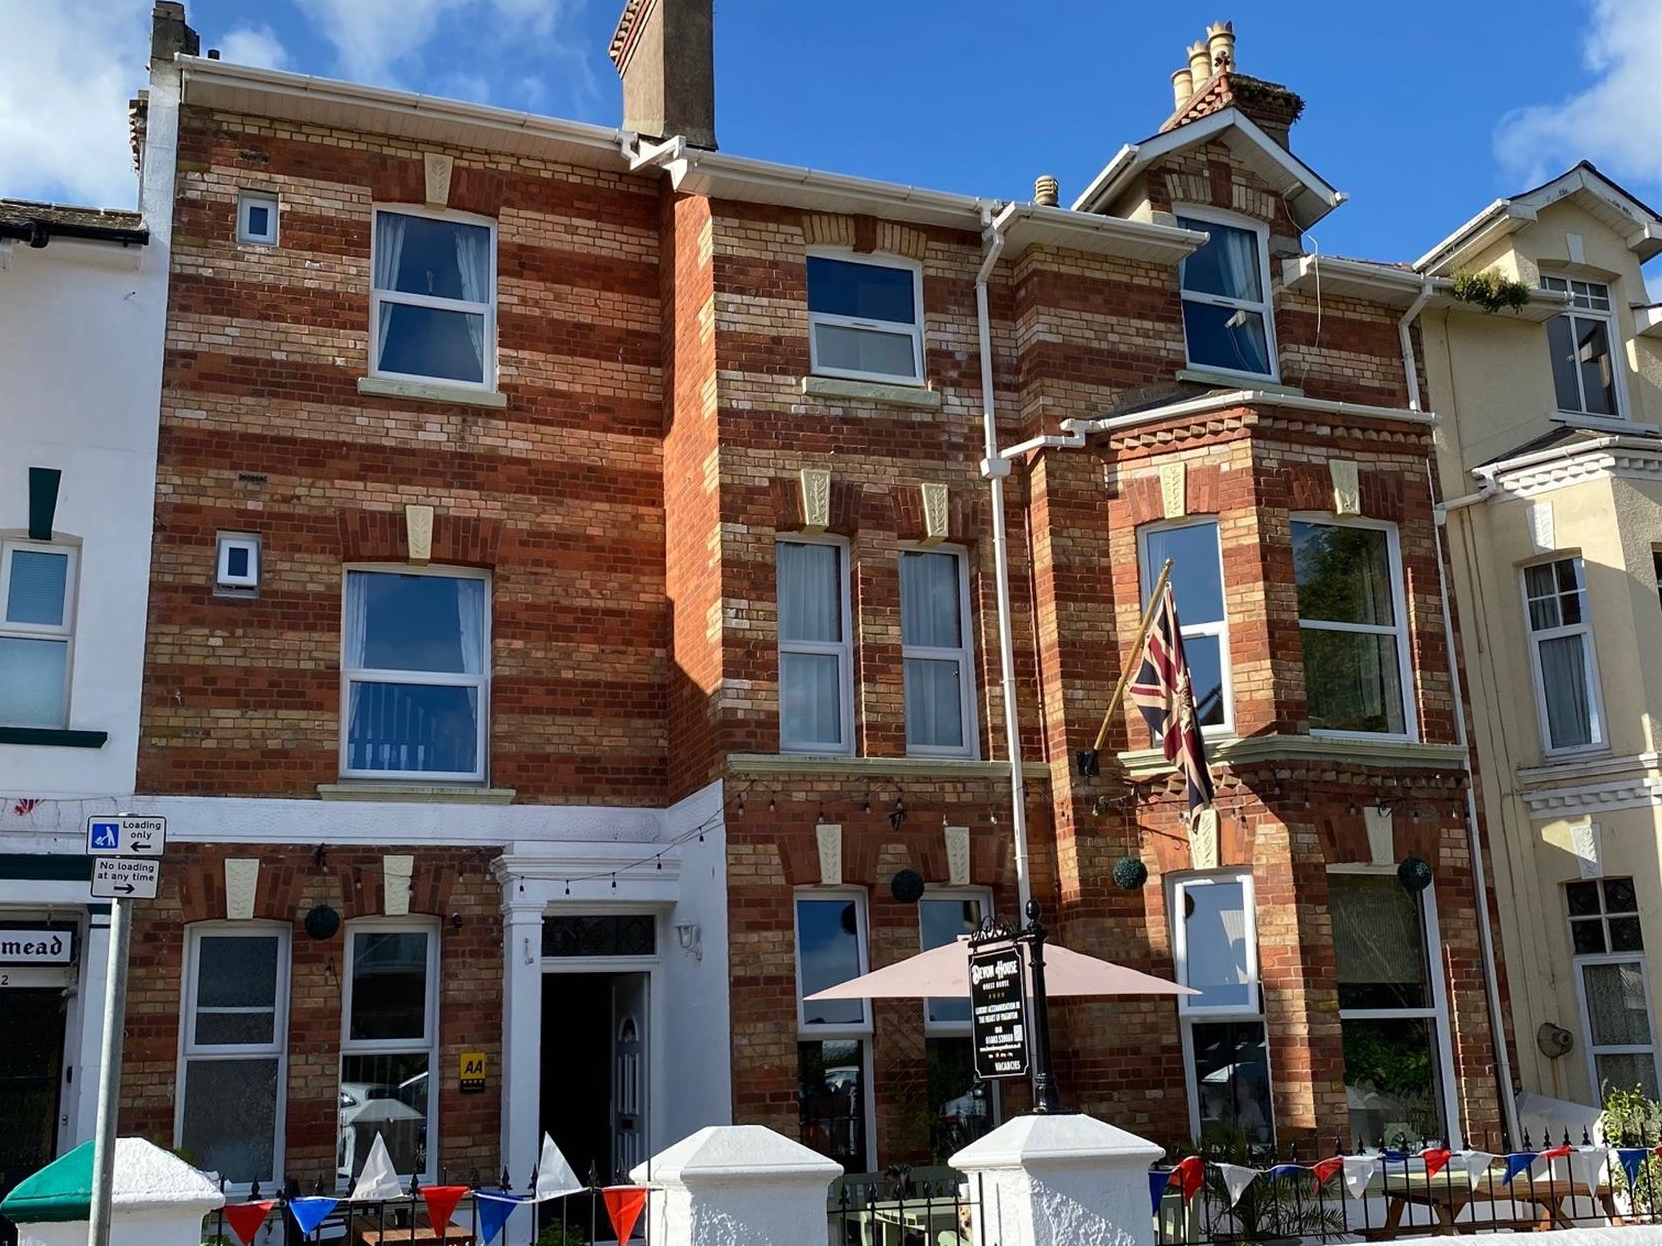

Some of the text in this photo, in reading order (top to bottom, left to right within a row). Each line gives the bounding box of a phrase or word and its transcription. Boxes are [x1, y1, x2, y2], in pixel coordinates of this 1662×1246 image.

[123, 821, 161, 830] Loading
[130, 831, 152, 840] only
[100, 862, 154, 873] No loading
[111, 873, 129, 882] any
[132, 873, 154, 881] time
[1, 935, 63, 955] mead
[1, 975, 9, 985] 2
[464, 1060, 483, 1074] AA
